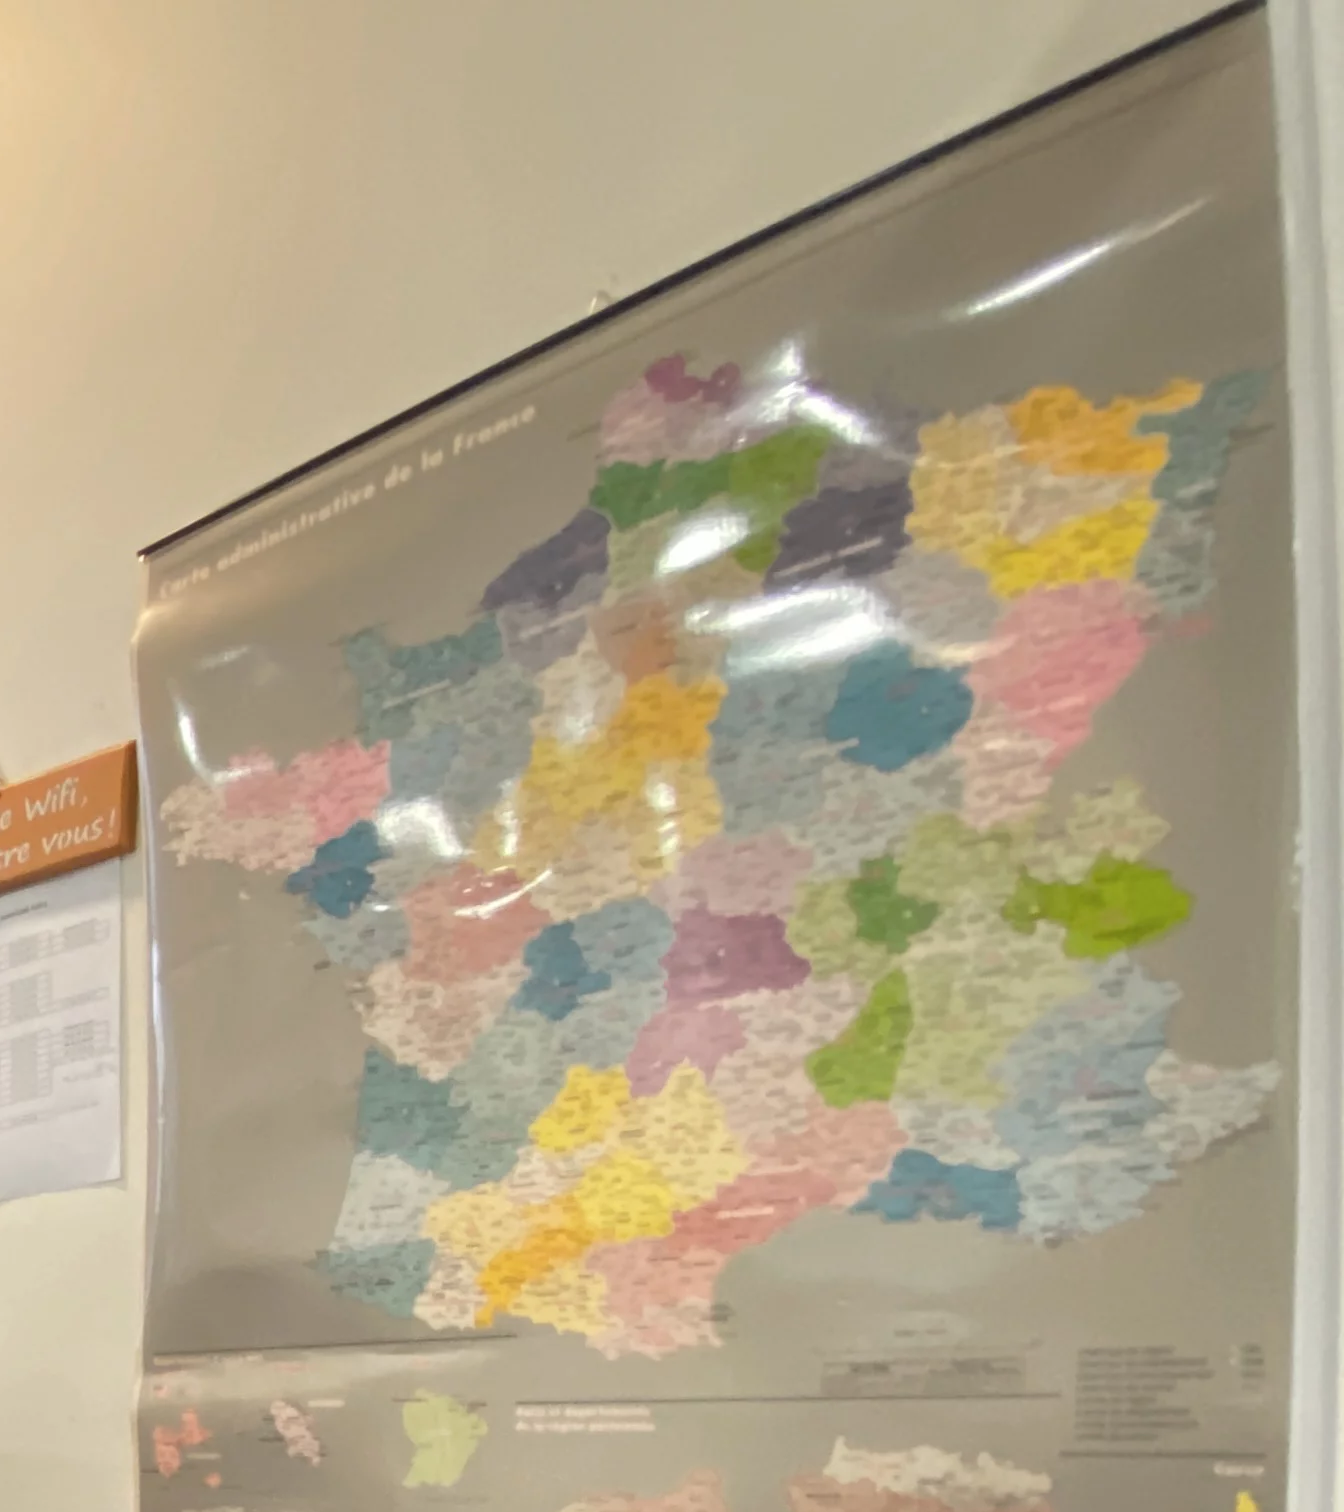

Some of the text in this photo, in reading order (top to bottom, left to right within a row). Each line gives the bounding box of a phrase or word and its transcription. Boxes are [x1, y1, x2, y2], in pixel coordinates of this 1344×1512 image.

[216, 484, 377, 573] administrative
[384, 463, 412, 490] de
[421, 449, 443, 472] la
[453, 405, 536, 457] France
[24, 776, 89, 821] Wifi,
